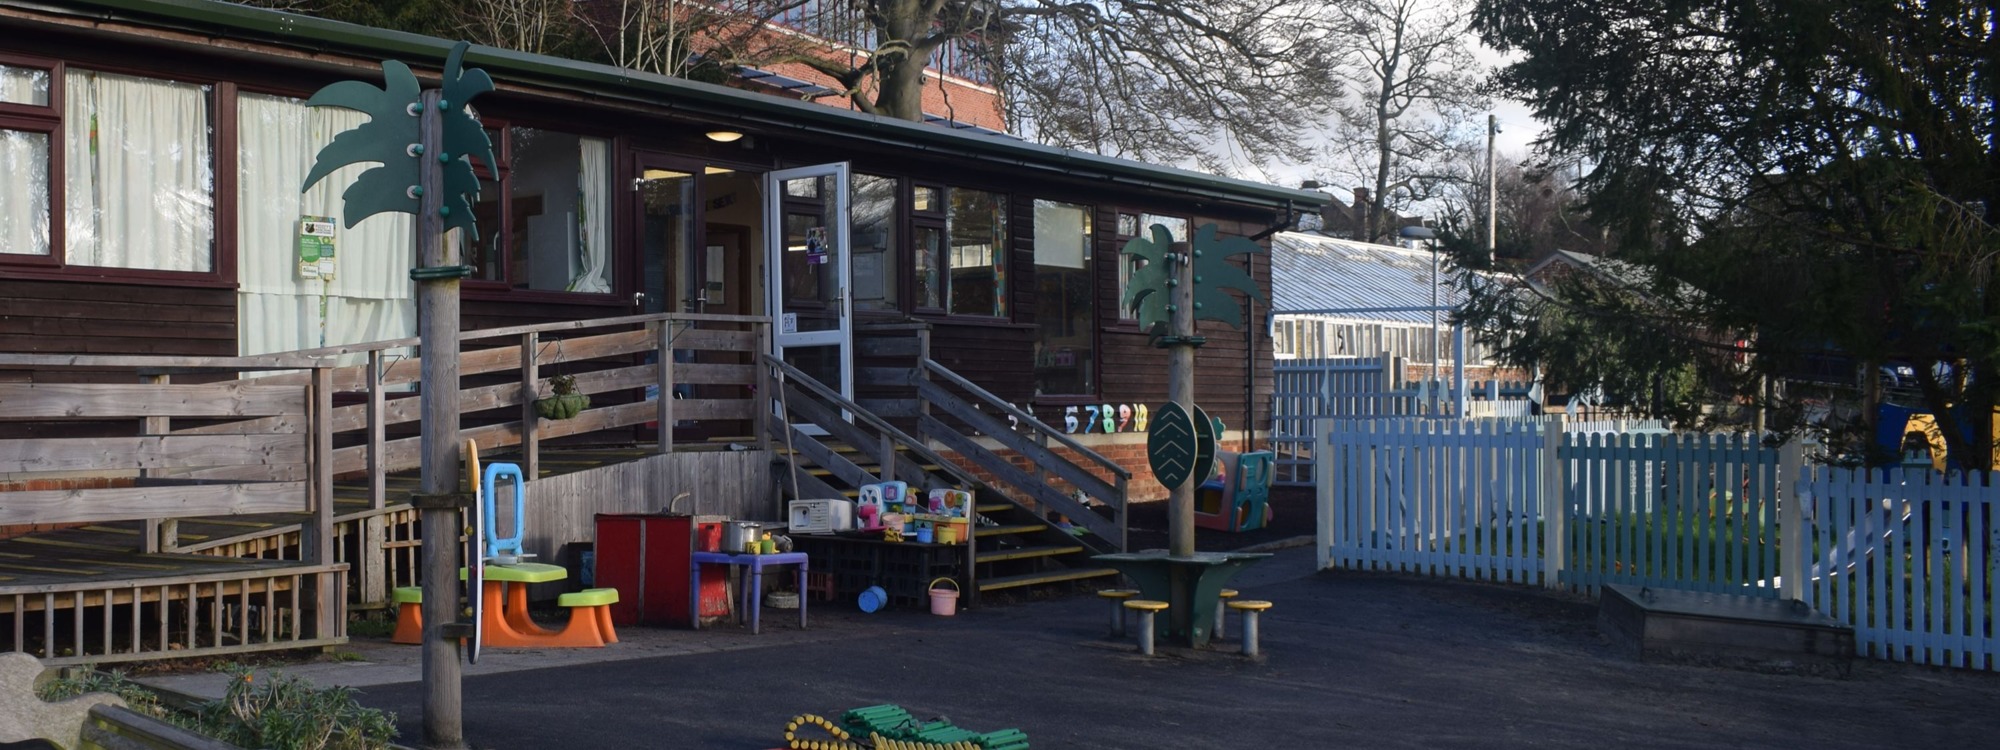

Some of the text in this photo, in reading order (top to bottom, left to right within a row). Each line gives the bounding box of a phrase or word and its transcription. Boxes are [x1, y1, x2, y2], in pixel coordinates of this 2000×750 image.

[1085, 405, 1099, 434] 7
[1102, 404, 1115, 434] 8
[1118, 404, 1131, 433] 9
[1133, 403, 1148, 432] 10
